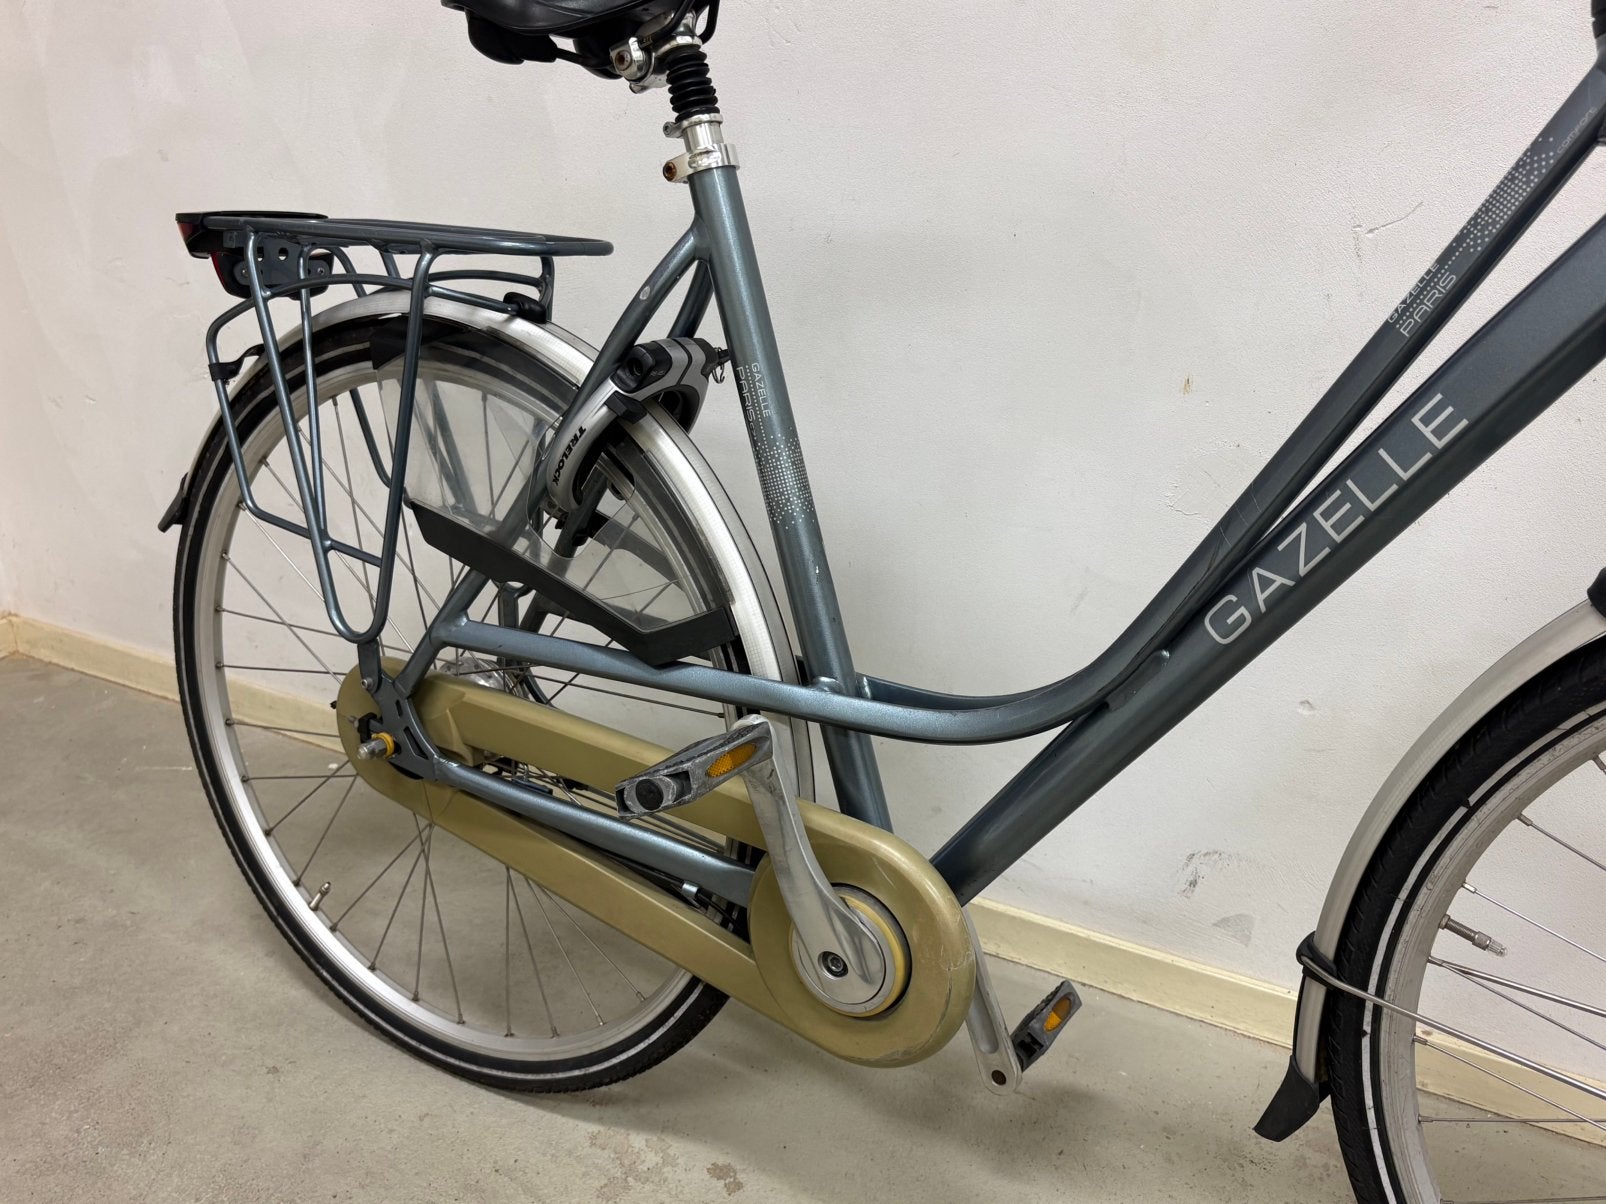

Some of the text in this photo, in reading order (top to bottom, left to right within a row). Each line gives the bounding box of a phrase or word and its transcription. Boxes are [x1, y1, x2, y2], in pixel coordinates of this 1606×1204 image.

[1387, 263, 1440, 323] GAZELLE
[1400, 271, 1457, 337] PARIS
[736, 366, 756, 421] PARIS
[751, 362, 771, 418] GAZELLE
[552, 425, 587, 487] TRELOCK
[1204, 392, 1469, 645] GAZELLE
